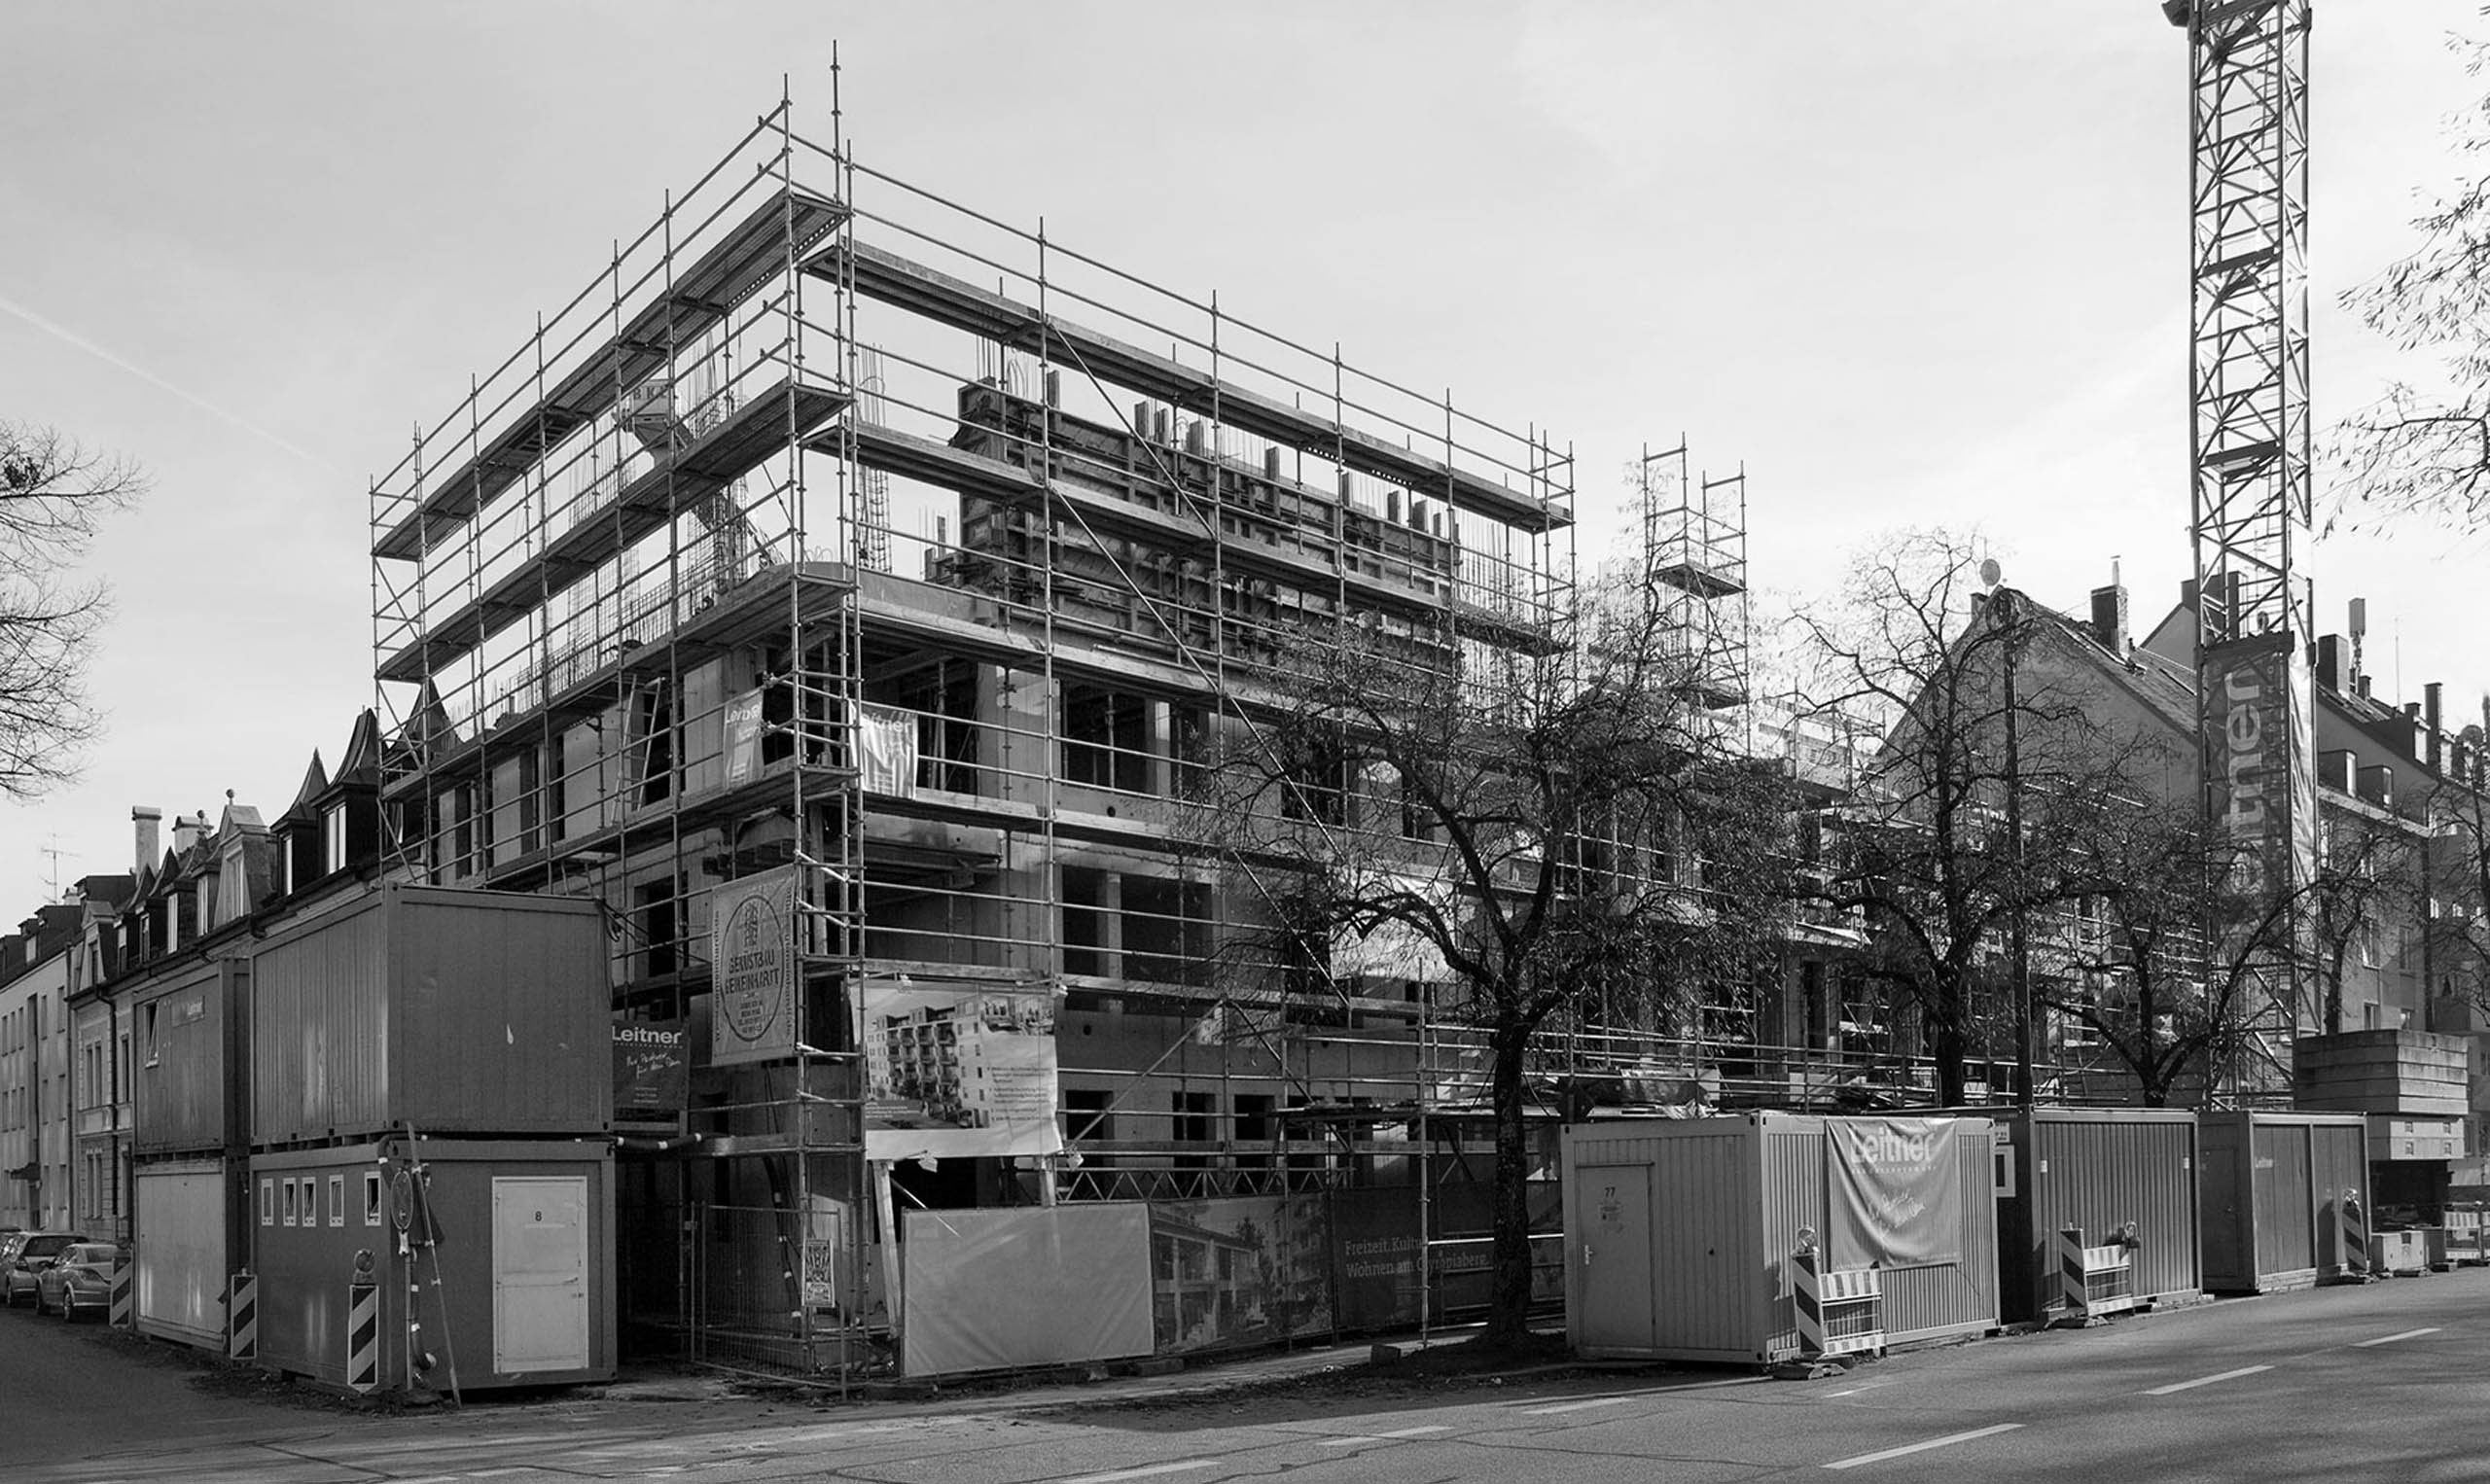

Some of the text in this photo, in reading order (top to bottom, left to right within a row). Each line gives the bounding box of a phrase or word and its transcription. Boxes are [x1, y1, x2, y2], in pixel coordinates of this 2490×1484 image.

[612, 1025, 682, 1043] Leitner
[1850, 1126, 1935, 1165] Leitner
[1605, 1186, 1616, 1198] 77
[535, 1210, 543, 1221] 8
[1346, 1258, 1394, 1278] Wohnen
[1397, 1259, 1414, 1274] am
